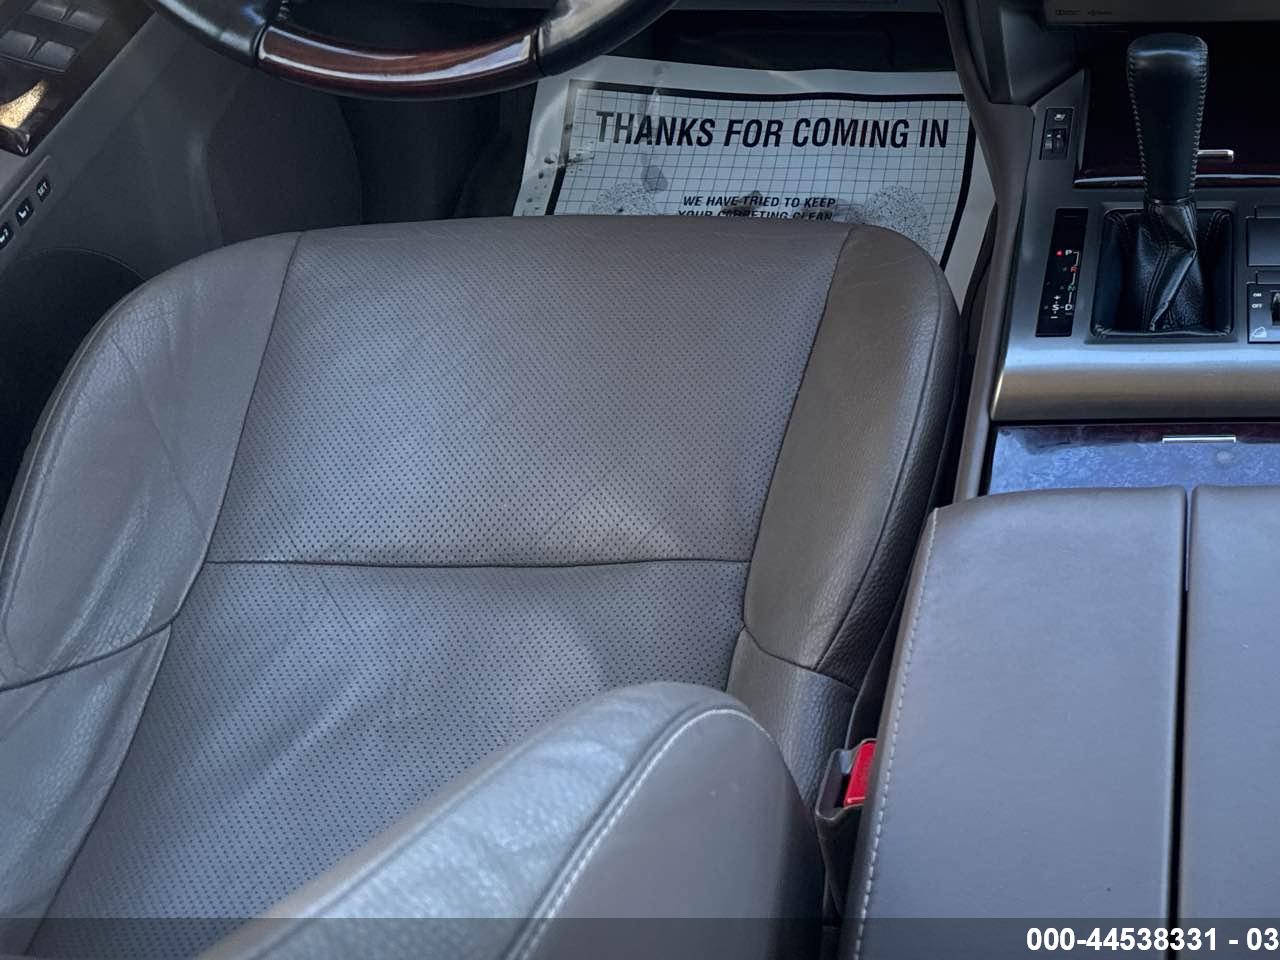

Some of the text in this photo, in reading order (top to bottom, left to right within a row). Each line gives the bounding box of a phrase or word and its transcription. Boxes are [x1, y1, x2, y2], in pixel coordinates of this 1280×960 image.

[596, 110, 949, 149] THANKS FOR COMING IN
[683, 195, 836, 209] WE HAVE TRIED TO KEEP
